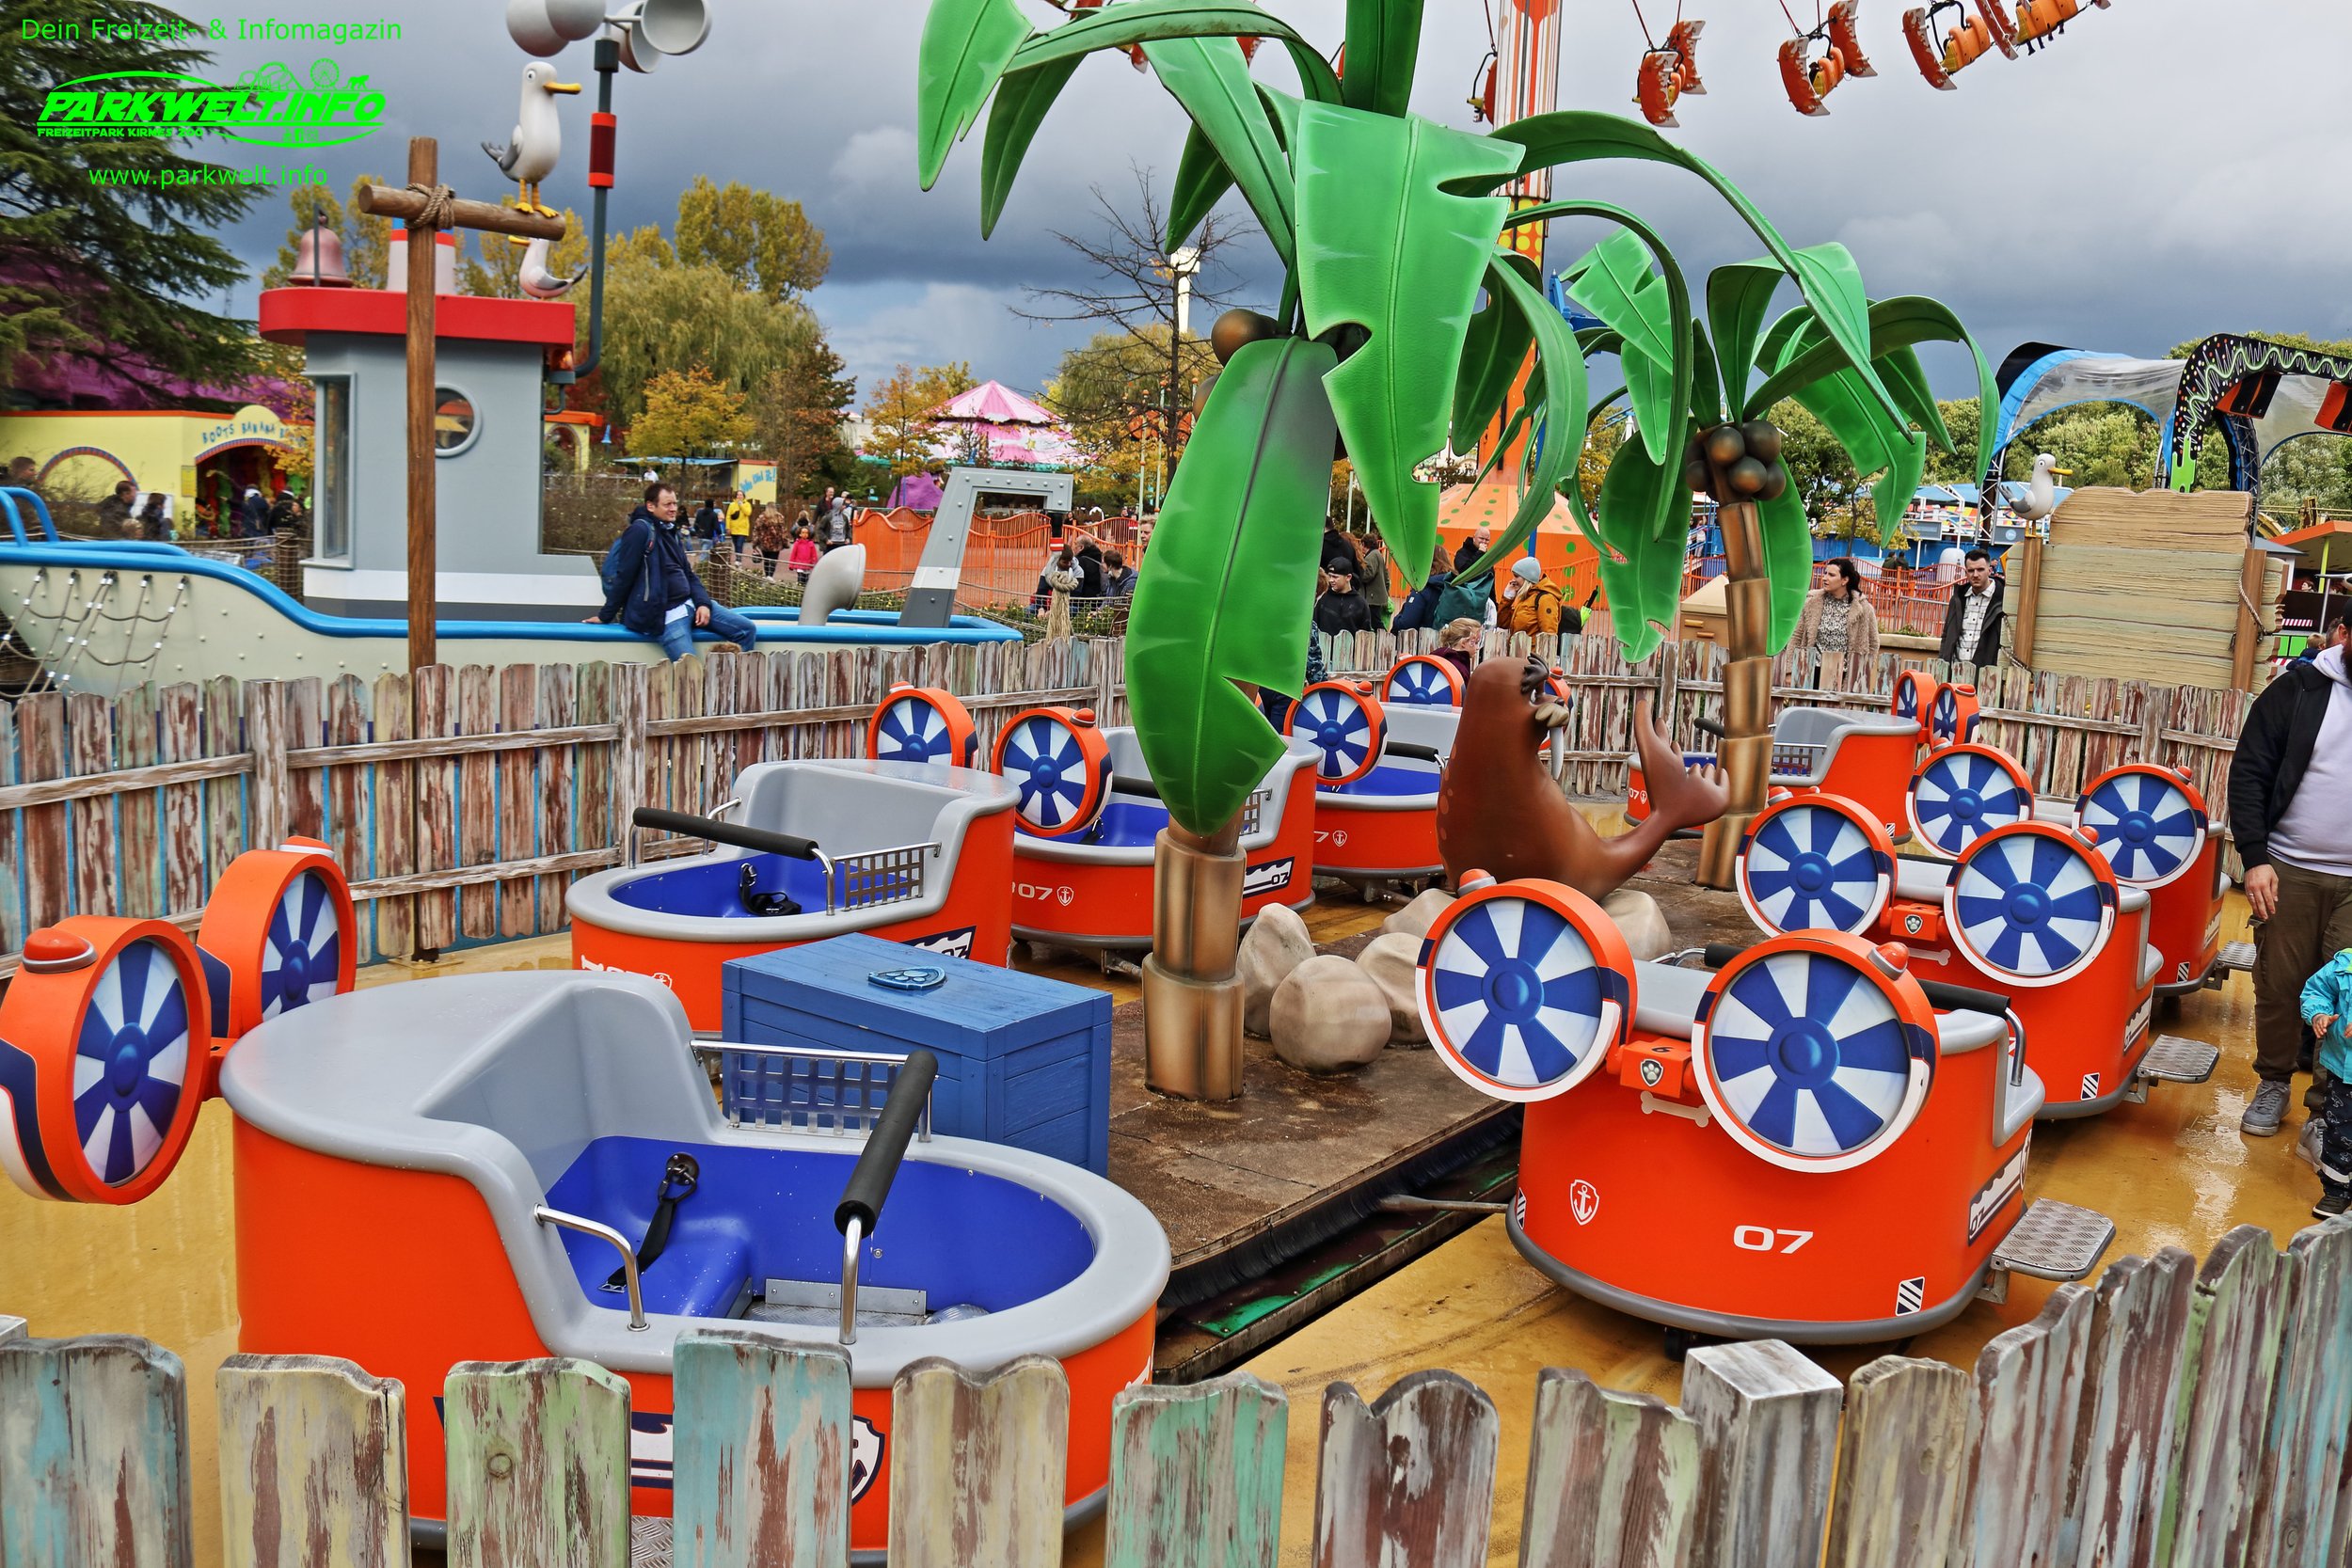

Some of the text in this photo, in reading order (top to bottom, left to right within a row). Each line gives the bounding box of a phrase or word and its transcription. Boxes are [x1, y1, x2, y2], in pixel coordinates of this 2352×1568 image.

[201, 421, 277, 444] BOOTS BANANA
[1018, 883, 1053, 900] 07
[1733, 1225, 1814, 1255] 07
